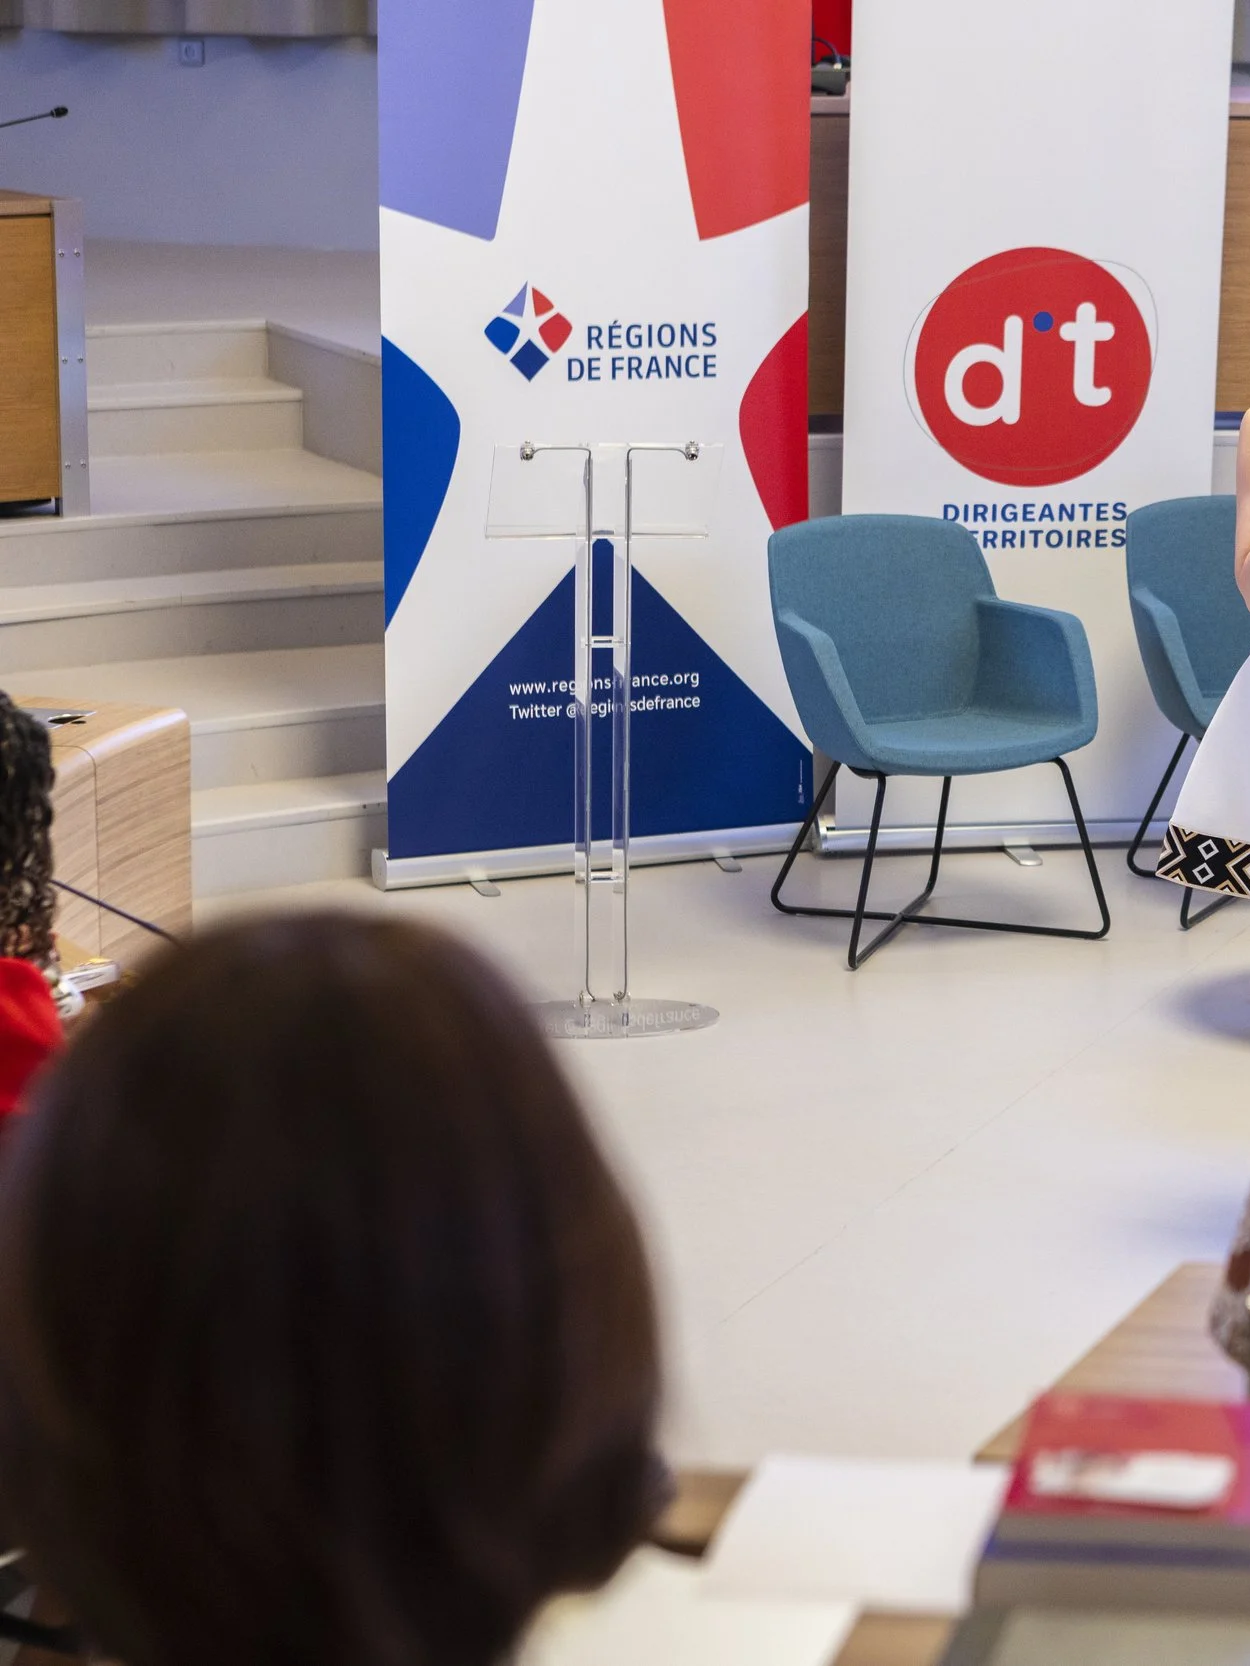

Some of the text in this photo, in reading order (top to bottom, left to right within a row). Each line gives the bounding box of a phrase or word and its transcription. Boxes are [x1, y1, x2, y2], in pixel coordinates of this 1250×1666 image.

[587, 320, 718, 350] RÉGIONS
[567, 354, 718, 382] DE FRANCE
[942, 502, 1127, 522] DIRIGEANTES
[969, 529, 1126, 548] RRITOIRES
[509, 671, 700, 696] www.regnsance.org
[509, 694, 701, 720] Twitter @egisdefrance
